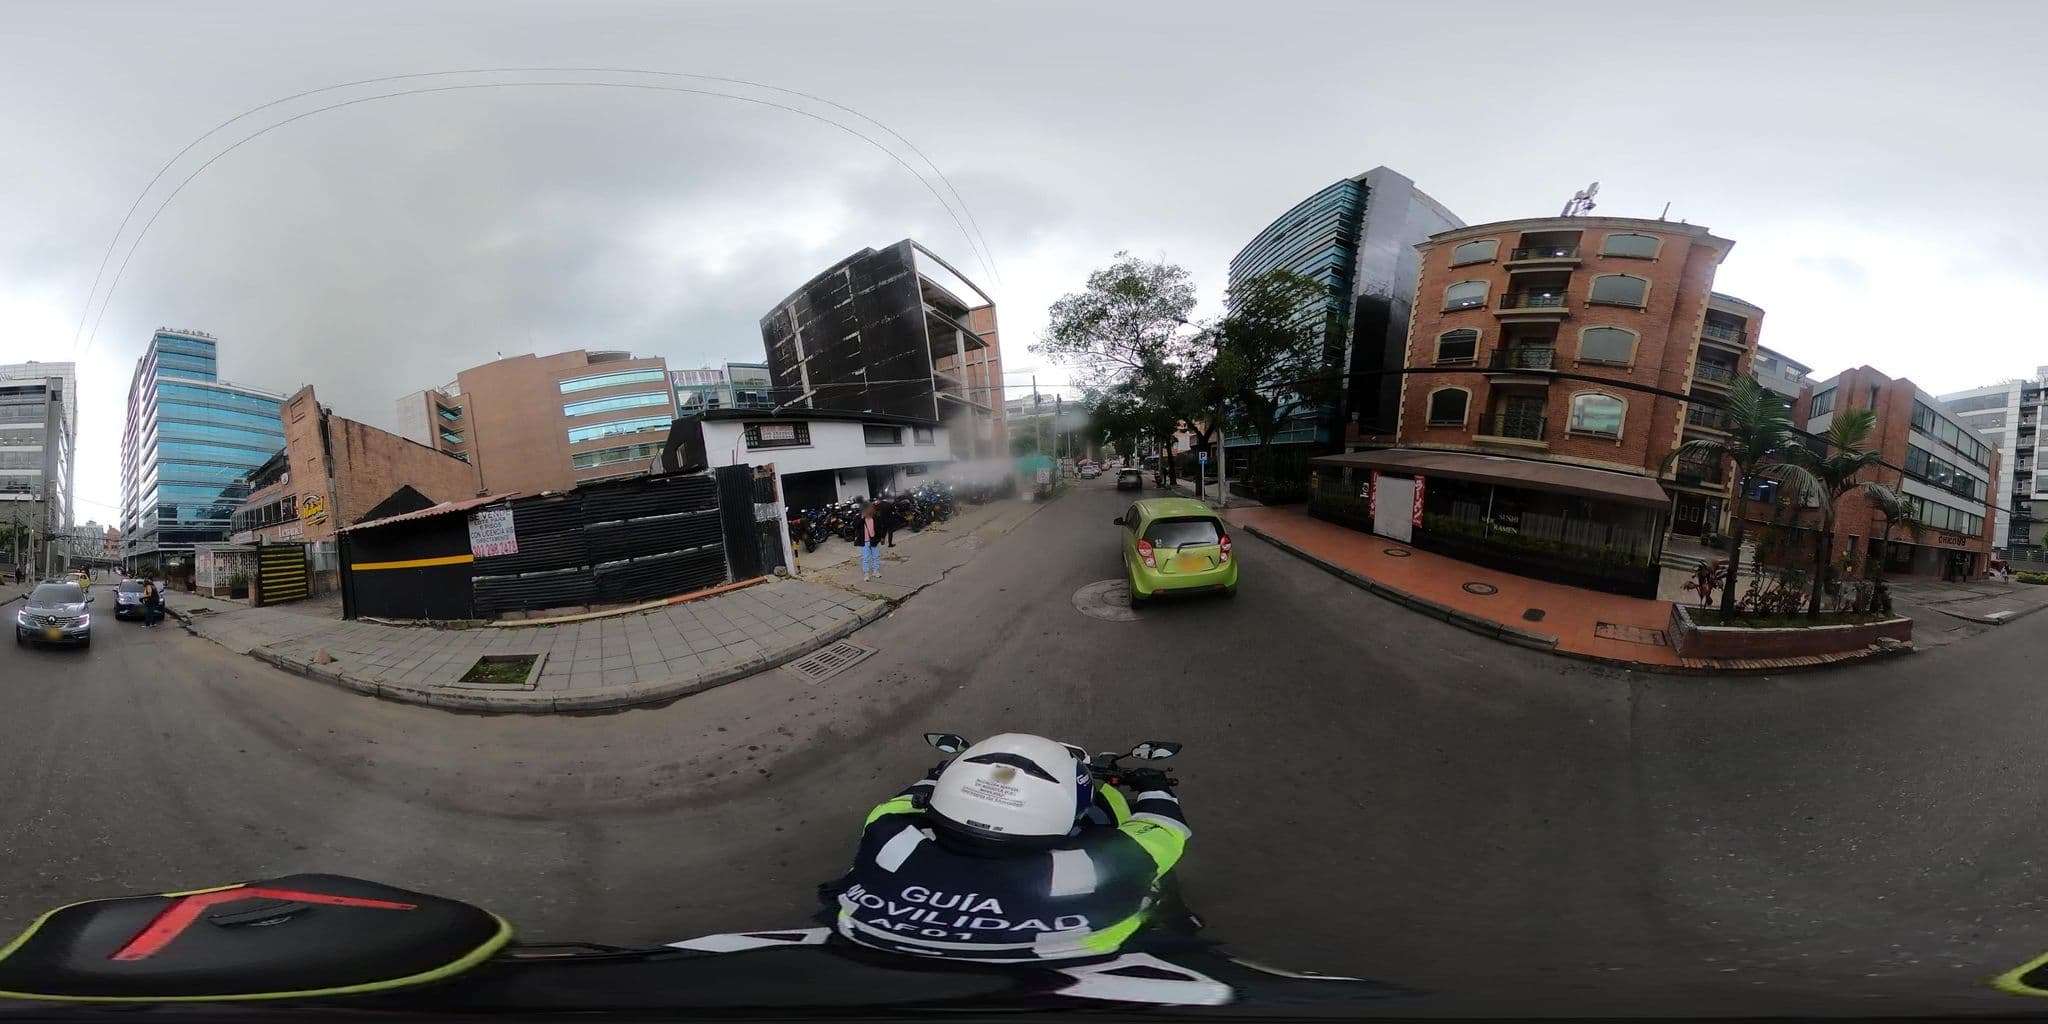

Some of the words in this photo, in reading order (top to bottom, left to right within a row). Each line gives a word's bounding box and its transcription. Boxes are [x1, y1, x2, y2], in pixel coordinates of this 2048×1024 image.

[469, 512, 481, 521] SE
[481, 510, 512, 519] VENDE
[1494, 523, 1517, 534] RAMEN
[846, 883, 1090, 932] MOVILIDAD
[900, 886, 1003, 914] GUÍA
[868, 918, 975, 940] AF01
